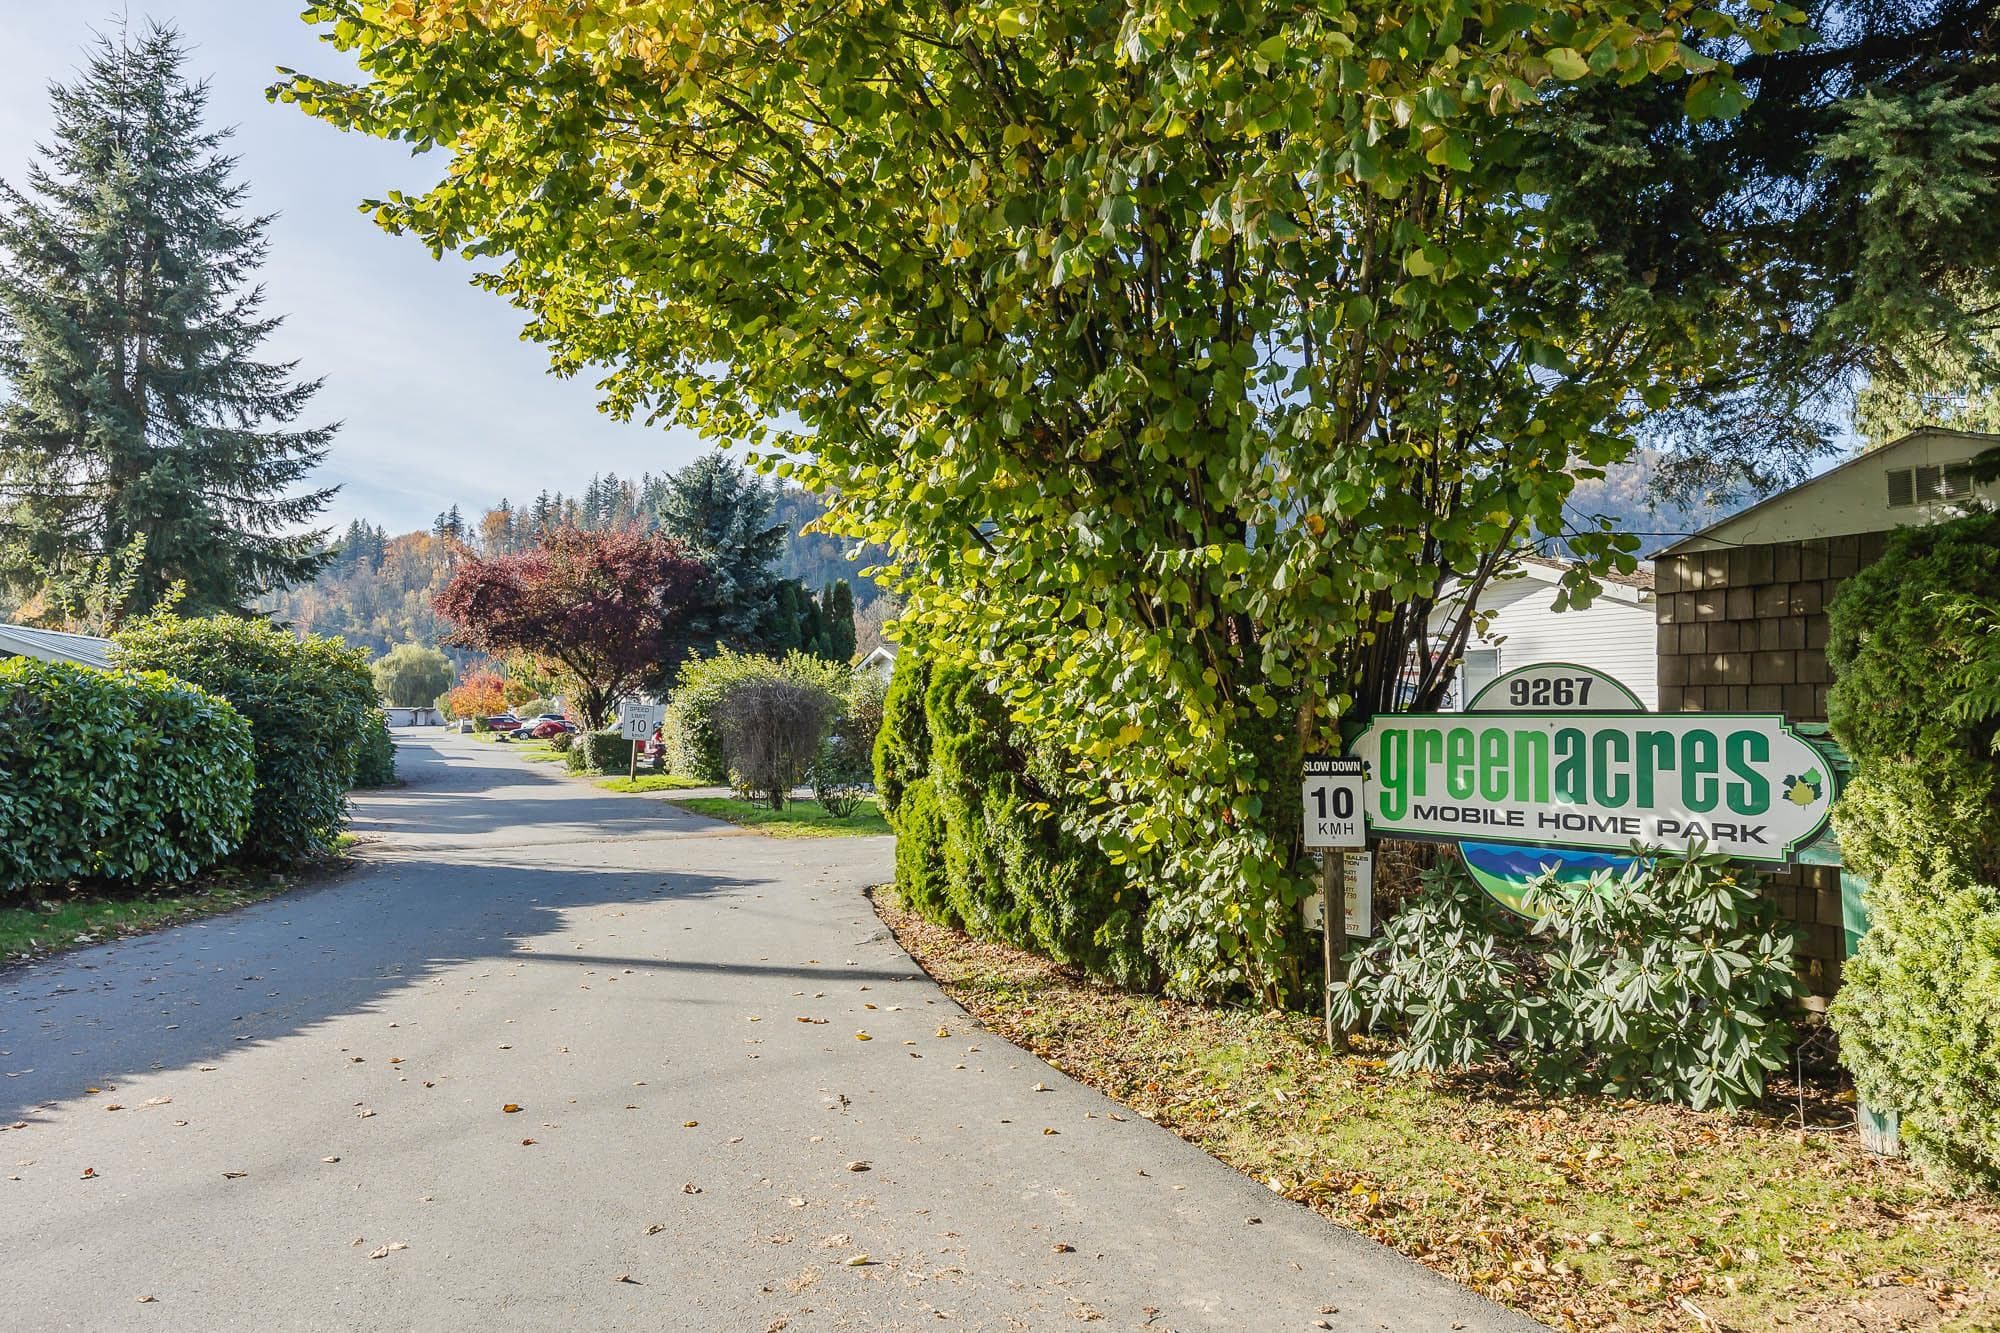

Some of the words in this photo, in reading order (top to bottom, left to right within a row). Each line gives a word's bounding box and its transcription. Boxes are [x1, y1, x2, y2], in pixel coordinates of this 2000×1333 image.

[1510, 677, 1593, 706] 9267
[630, 719, 647, 732] 10
[1303, 761, 1330, 772] SLOW
[1331, 761, 1360, 772] DOWN
[1380, 727, 1771, 822] greenacres
[1310, 786, 1354, 819] 10
[1318, 822, 1354, 835] KMH
[1413, 804, 1525, 827] MOBILE
[1538, 812, 1641, 835] HOME
[1657, 819, 1769, 845] PARK
